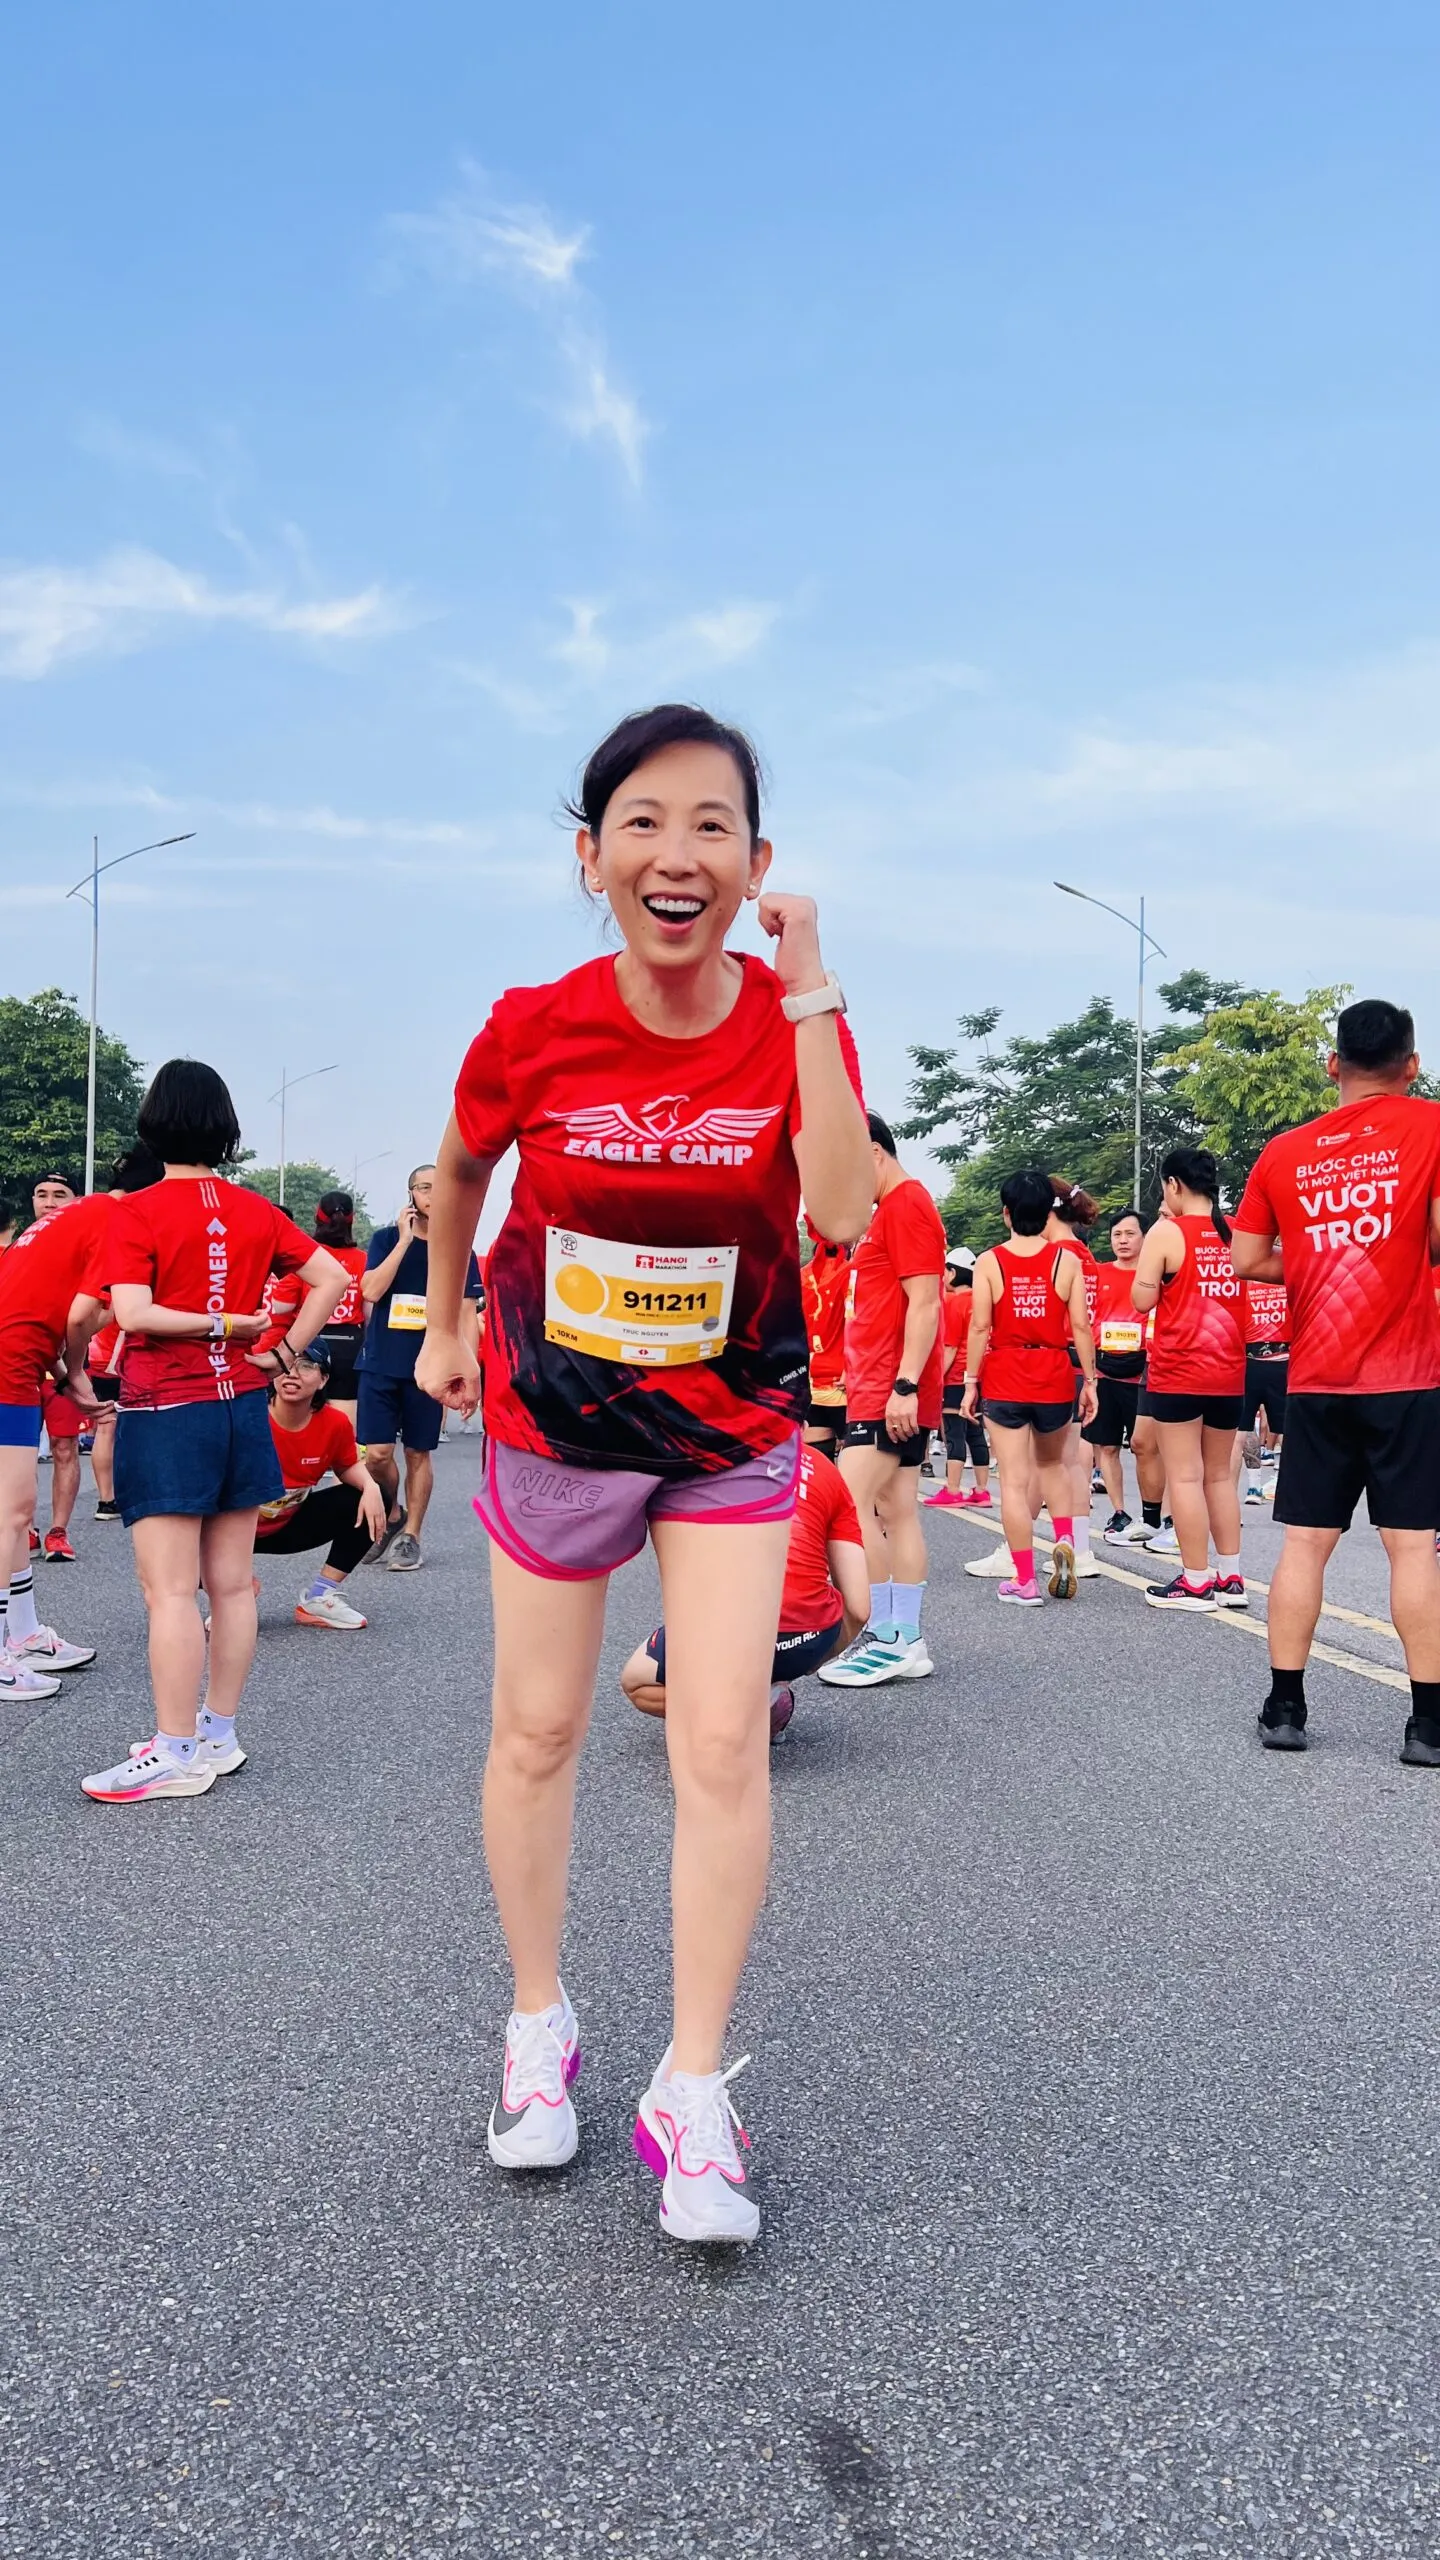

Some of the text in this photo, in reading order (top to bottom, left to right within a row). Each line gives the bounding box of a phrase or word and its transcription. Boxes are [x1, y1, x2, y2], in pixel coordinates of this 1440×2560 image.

[563, 1138, 753, 1166] EAGLE CAMP
[1296, 1149, 1399, 1178] BƯỚC CHẠY
[1296, 1164, 1399, 1191] VÌ MỘT VIỆT NAM
[1298, 1180, 1399, 1217] VƯỢT
[1304, 1212, 1391, 1252] TRỘI
[655, 1256, 688, 1264] HANOI
[1198, 1278, 1240, 1299] TRỘI
[623, 1290, 707, 1312] 911211
[1013, 1295, 1046, 1306] VƯỢT
[1013, 1306, 1045, 1318] TRỘI
[1252, 1310, 1285, 1325] TRỘI
[557, 1329, 578, 1342] 10KM
[513, 1467, 604, 1509] NIKE
[1167, 1589, 1186, 1598] HOKA
[776, 1636, 802, 1651] YOUR
